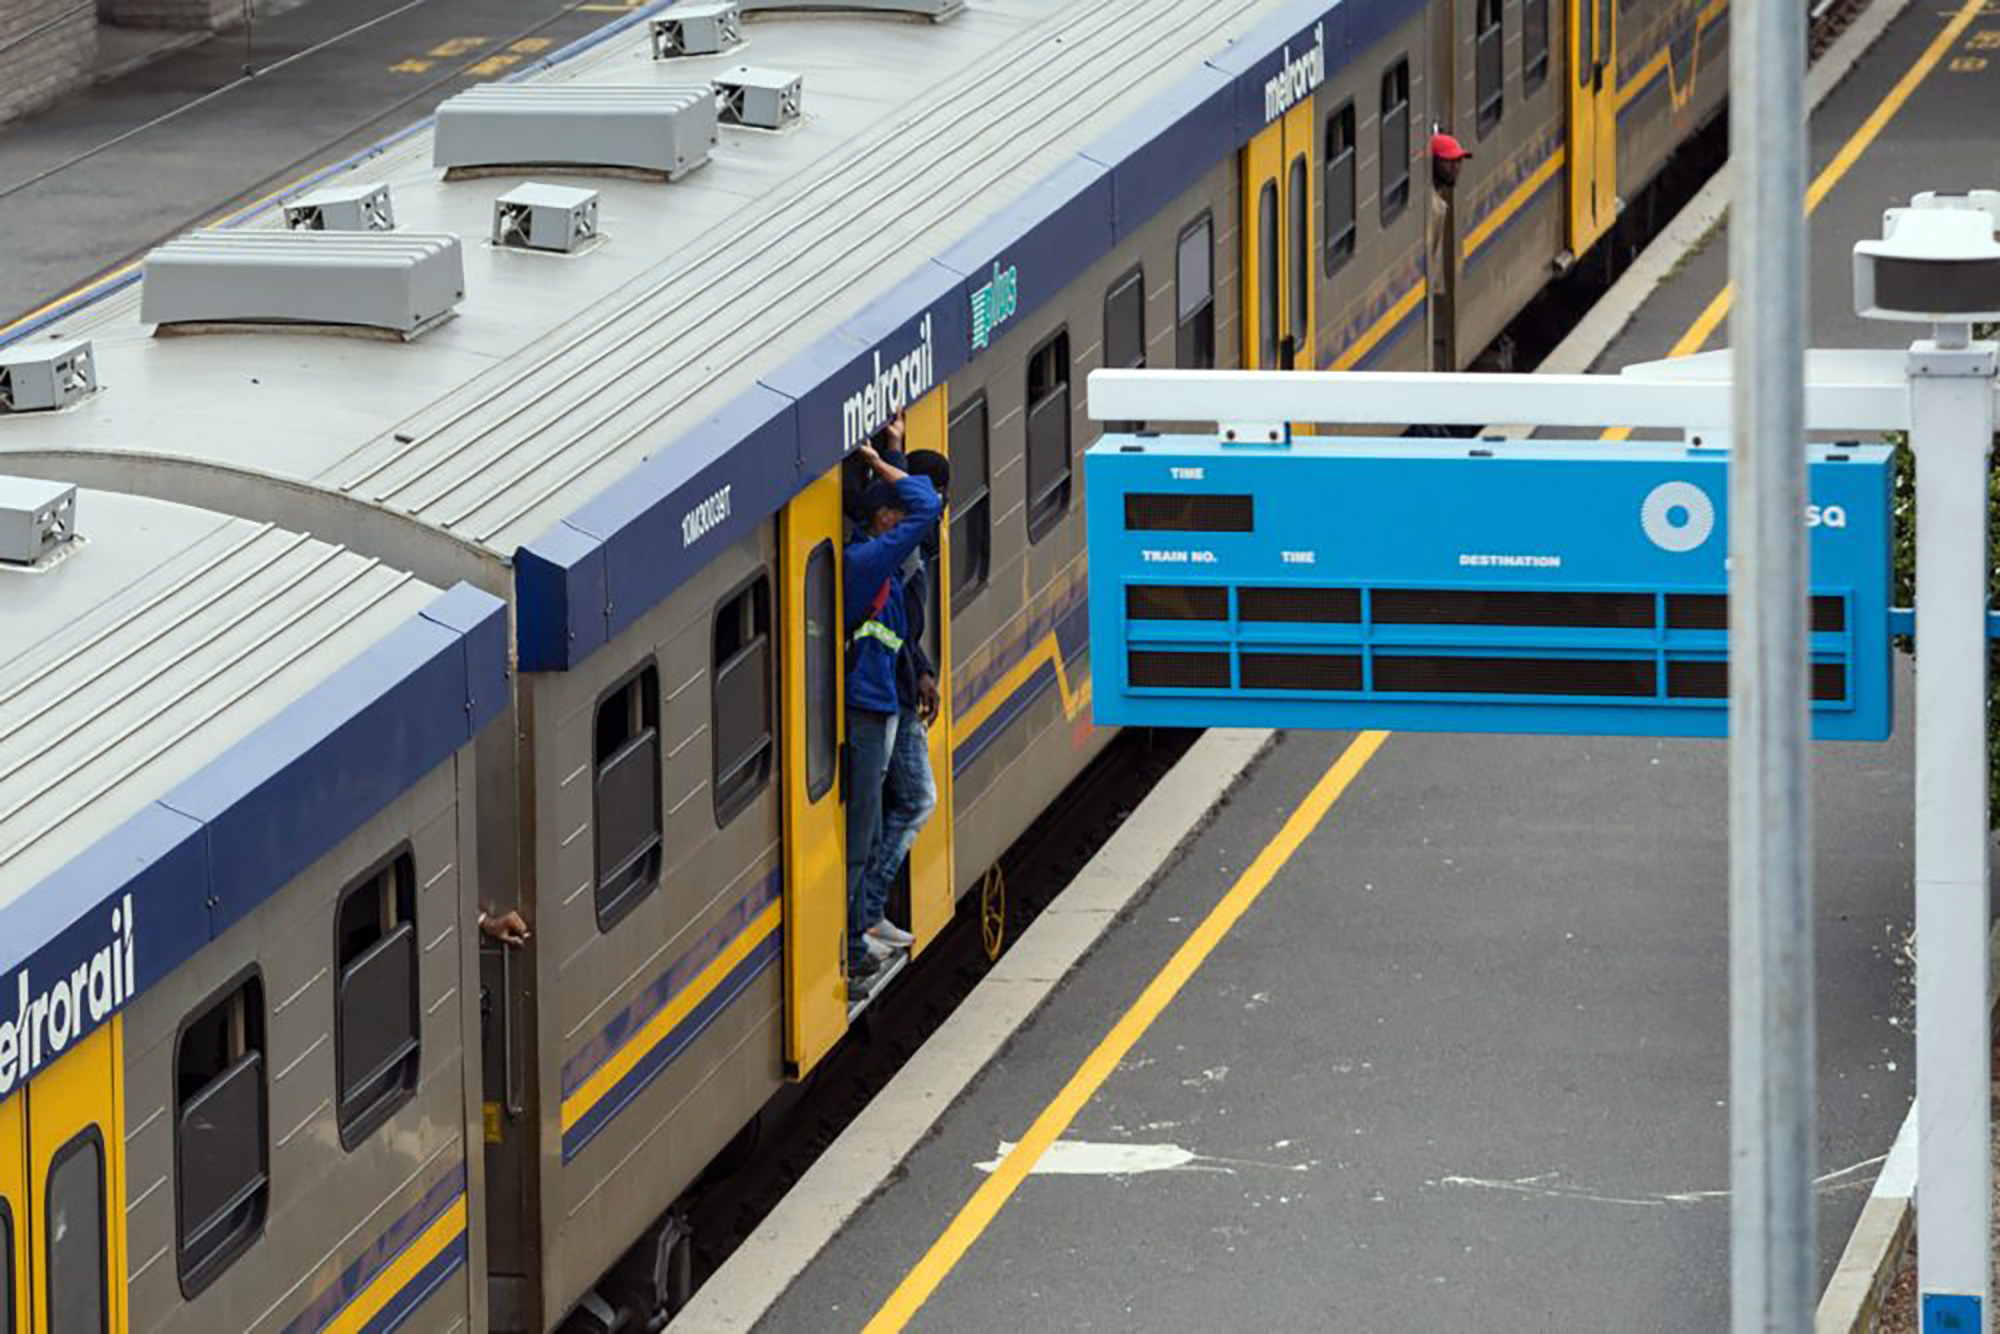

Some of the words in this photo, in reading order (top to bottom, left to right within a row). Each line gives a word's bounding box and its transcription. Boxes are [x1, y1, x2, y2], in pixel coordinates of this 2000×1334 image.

[1265, 21, 1325, 123] metrorail
[843, 311, 933, 452] metrorail
[1169, 467, 1205, 480] TIME
[1142, 550, 1188, 563] TRAIN
[1191, 551, 1218, 563] NO.
[1280, 551, 1316, 564] TIME
[1459, 554, 1561, 568] DESTINATION
[0, 893, 135, 1094] etrorail
